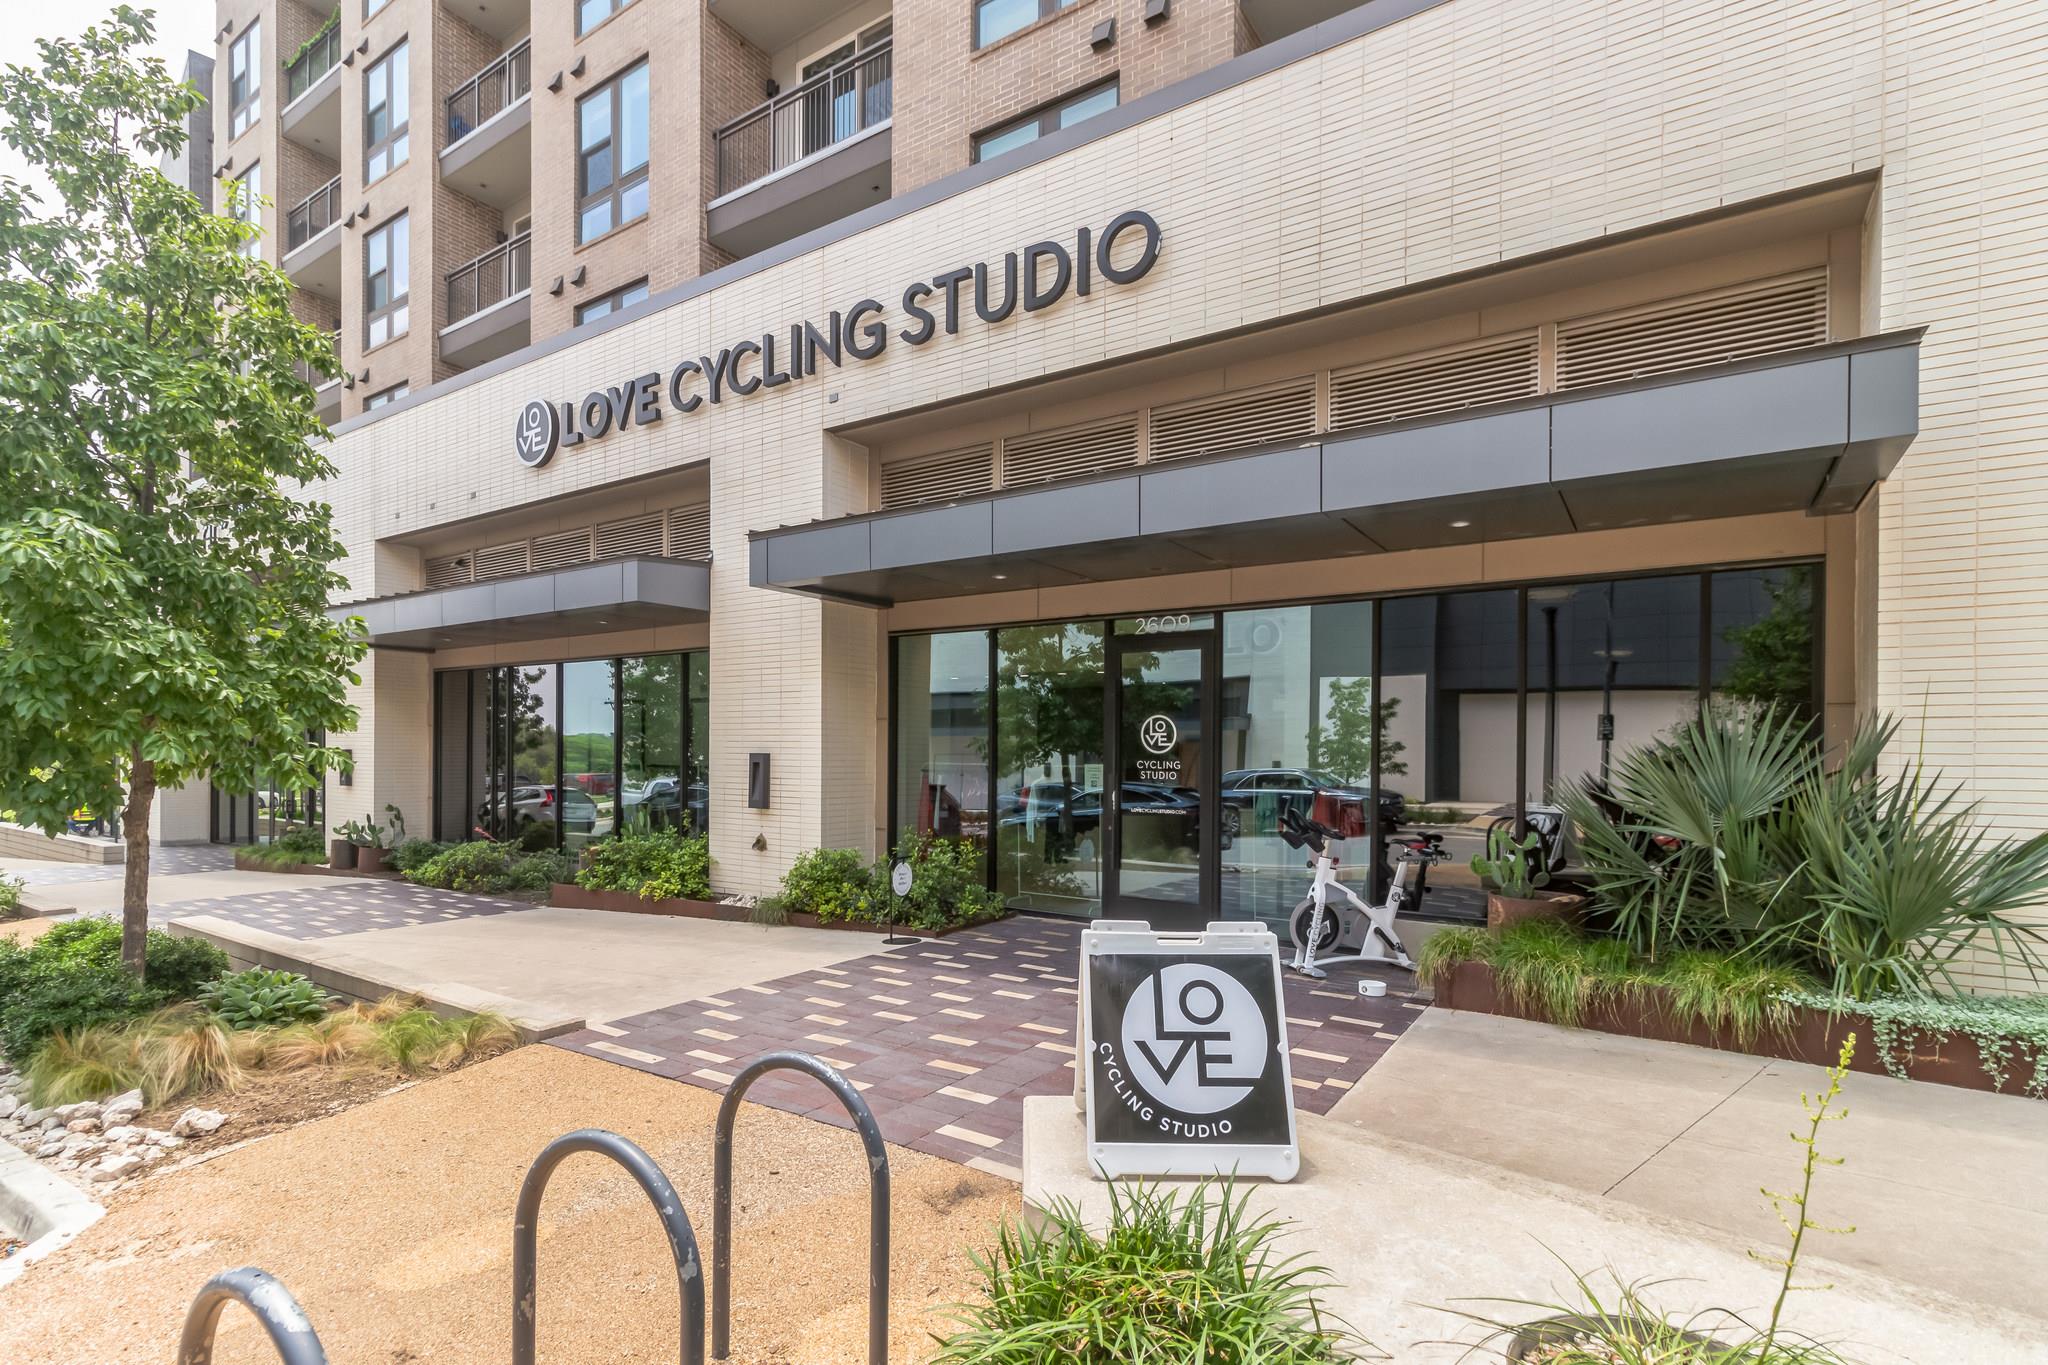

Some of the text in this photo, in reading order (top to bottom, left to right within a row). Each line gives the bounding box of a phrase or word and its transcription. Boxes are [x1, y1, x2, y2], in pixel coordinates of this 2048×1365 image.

[560, 210, 1162, 447] LOVE CYCLING STUDIO
[1135, 614, 1191, 635] 2609
[1136, 760, 1181, 770] CYCLING
[1140, 770, 1177, 780] STUDIO
[1308, 938, 1318, 958] LOVE
[1100, 1042, 1232, 1138] CYCLING STUDIO
